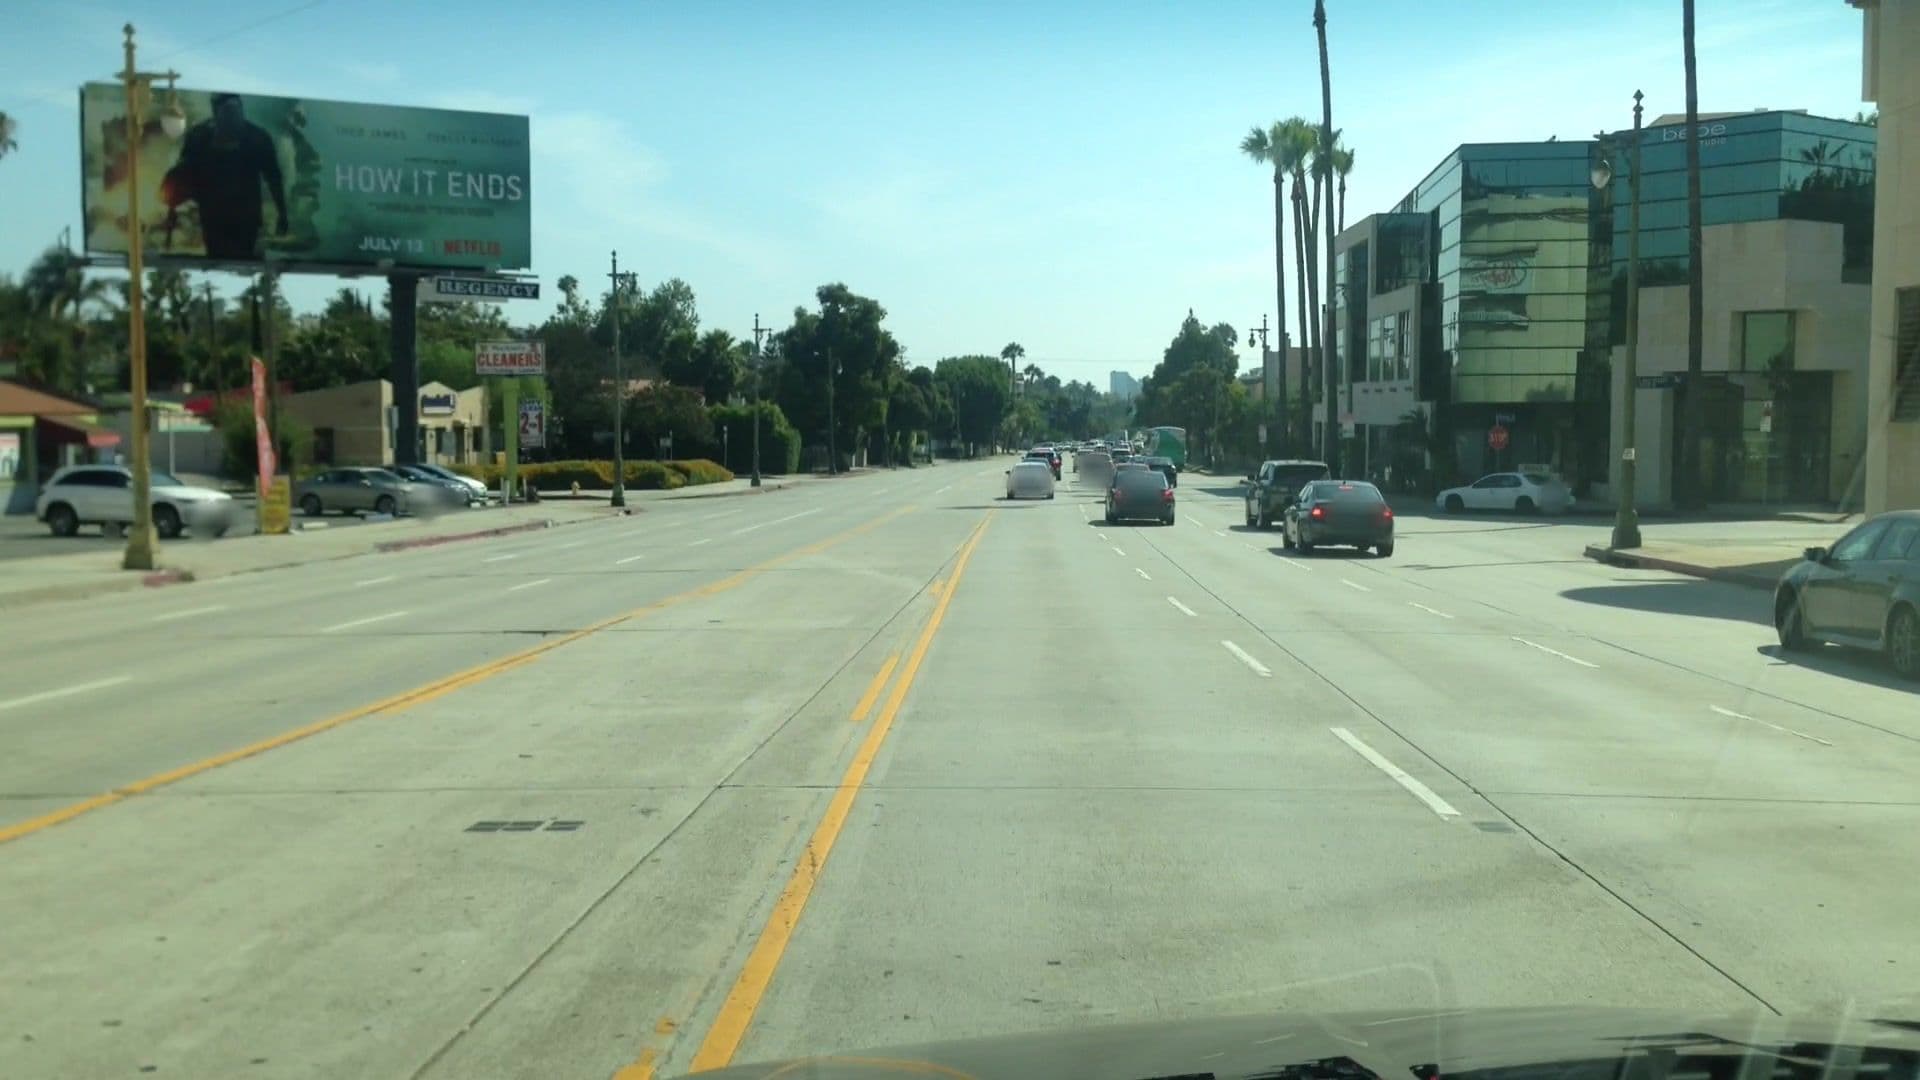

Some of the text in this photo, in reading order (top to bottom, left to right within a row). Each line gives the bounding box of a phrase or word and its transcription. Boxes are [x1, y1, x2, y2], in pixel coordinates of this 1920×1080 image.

[335, 164, 522, 201] HOW IT ENDS
[359, 236, 423, 253] JULY 13
[444, 239, 501, 256] NETFLIX
[440, 280, 537, 297] REGENCY
[477, 352, 541, 367] CLEANERS
